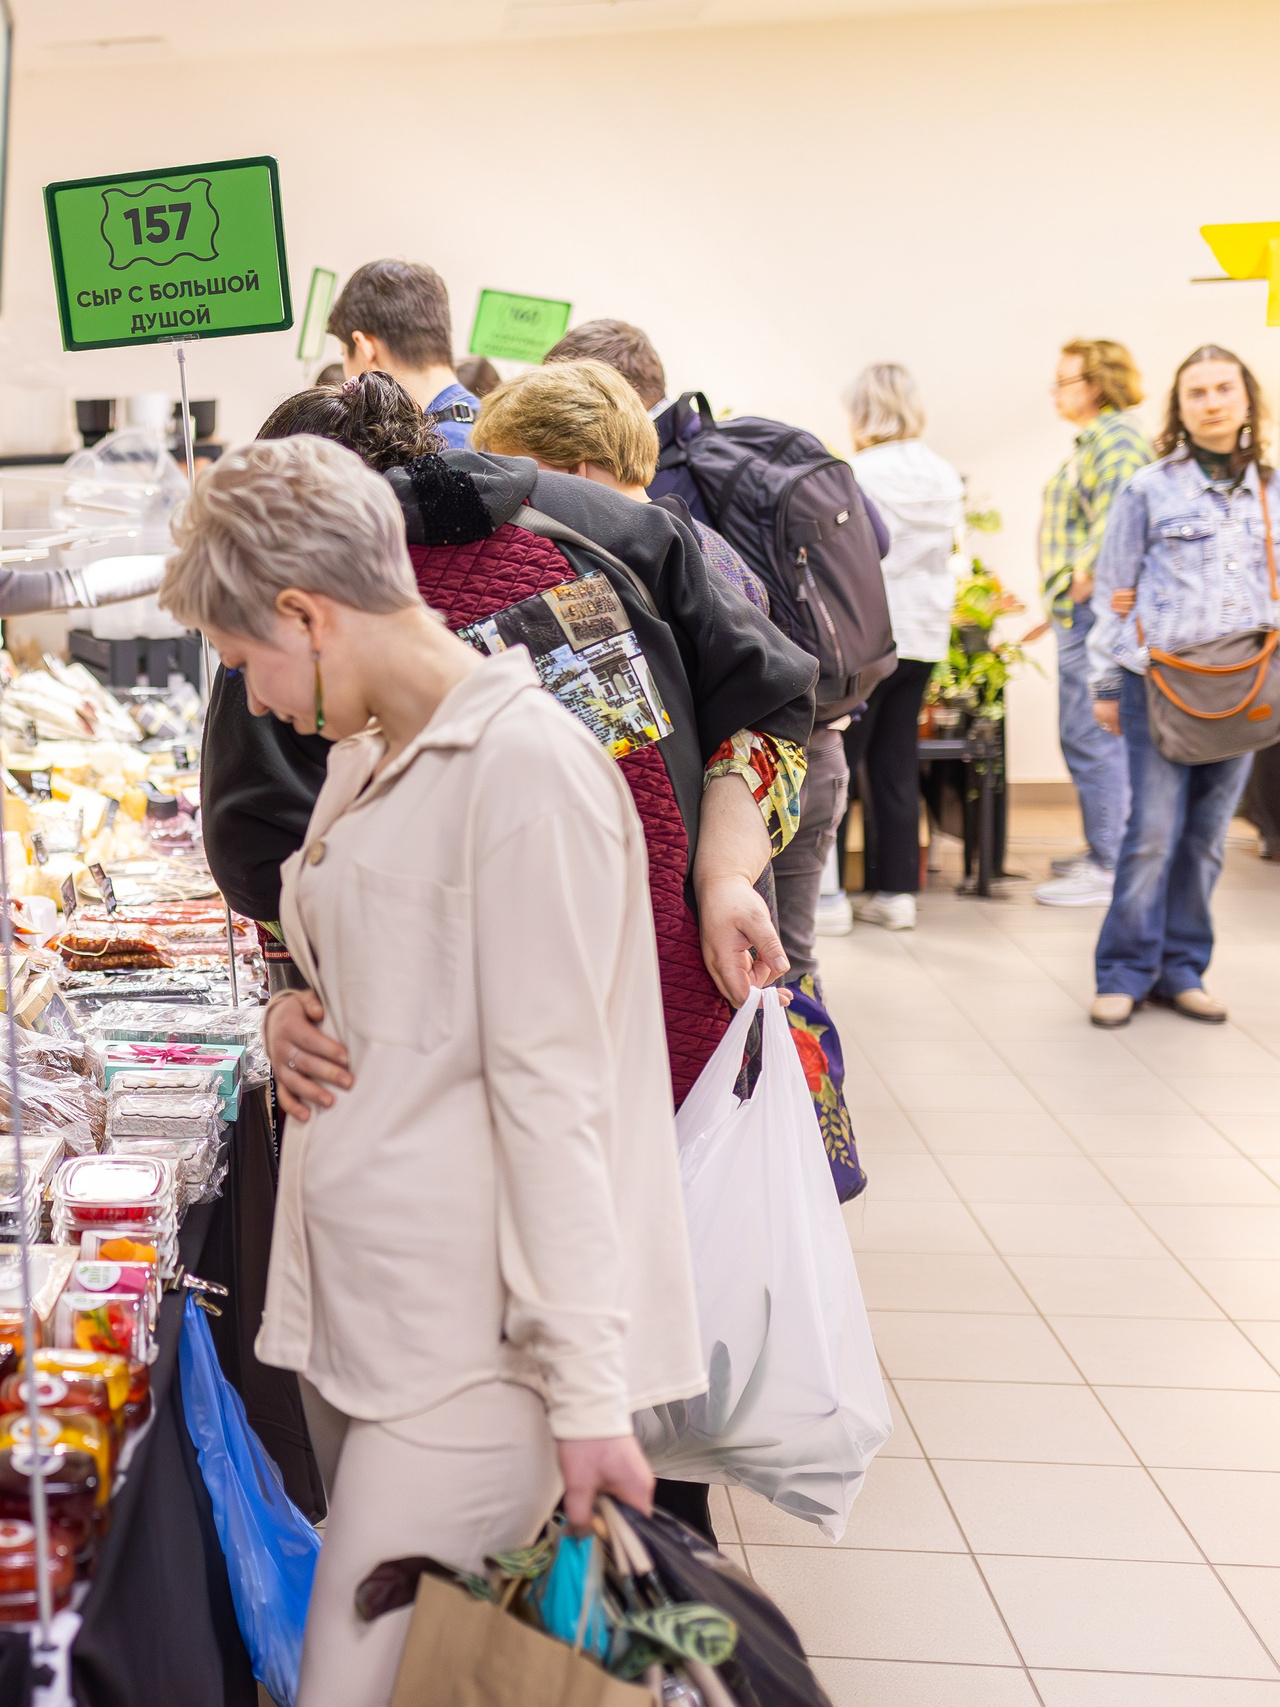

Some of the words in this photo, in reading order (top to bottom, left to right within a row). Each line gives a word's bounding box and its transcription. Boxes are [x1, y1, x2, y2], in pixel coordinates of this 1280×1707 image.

[123, 202, 191, 246] 157
[76, 287, 122, 308] СЫР
[128, 285, 144, 303] С
[149, 269, 260, 301] БОЛЬШОЙ
[130, 303, 211, 334] ДУШОЙ
